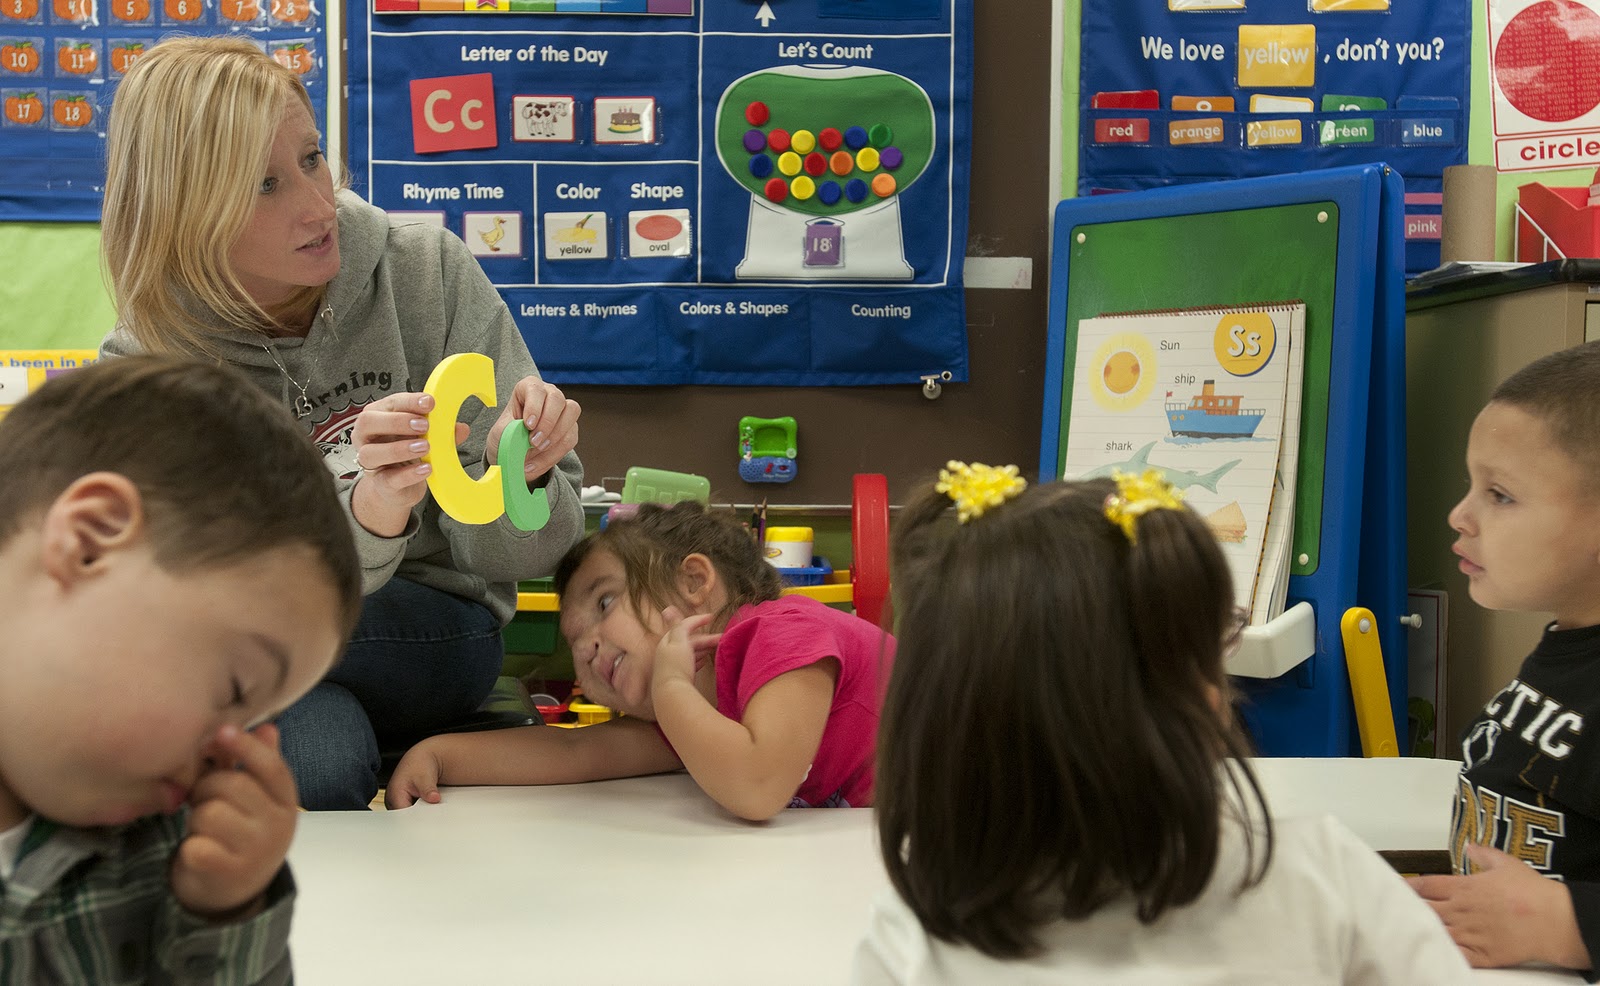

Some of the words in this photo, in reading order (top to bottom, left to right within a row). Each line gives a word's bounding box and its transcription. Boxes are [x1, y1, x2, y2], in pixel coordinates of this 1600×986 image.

[14, 0, 22, 14] 3
[68, 1, 76, 15] 4
[126, 1, 135, 16] 5
[178, 1, 187, 15] 6
[236, 1, 243, 15] 7
[286, 2, 295, 16] 8
[461, 45, 512, 61] Letter
[516, 45, 535, 61] of
[540, 45, 570, 62] the
[574, 47, 608, 66] Day
[778, 42, 818, 59] Let's
[821, 42, 873, 59] Count
[1141, 36, 1174, 60] We
[1179, 38, 1225, 61] love
[1244, 42, 1310, 69] yellow
[1336, 38, 1390, 61] don't
[1396, 37, 1445, 65] you?
[11, 52, 28, 67] 10
[71, 54, 85, 68] 11
[286, 54, 300, 69] 15
[17, 104, 30, 118] 17
[65, 106, 80, 121] 18
[423, 89, 484, 133] Cc
[1109, 124, 1134, 137] red
[1171, 125, 1221, 139] orange
[1252, 126, 1297, 140] yellow
[1413, 124, 1443, 137] blue
[1520, 138, 1600, 161] circle
[403, 184, 460, 204] Rhyme
[464, 183, 504, 199] Time
[556, 183, 601, 200] Color
[630, 183, 684, 201] Shape
[1408, 220, 1437, 236] pink
[560, 245, 592, 256] yellow
[649, 242, 670, 252] oval
[521, 303, 566, 318] Letters
[569, 304, 581, 317] &
[584, 303, 637, 319] Rhymes
[679, 302, 722, 315] Colors
[725, 303, 736, 315] &
[739, 303, 789, 318] Shapes
[851, 304, 911, 319] Counting
[1160, 340, 1180, 351] Sun
[1227, 324, 1261, 357] Ss
[10, 358, 54, 368] been
[60, 356, 76, 368] in
[1174, 374, 1196, 386] ship
[1105, 441, 1133, 452] shark
